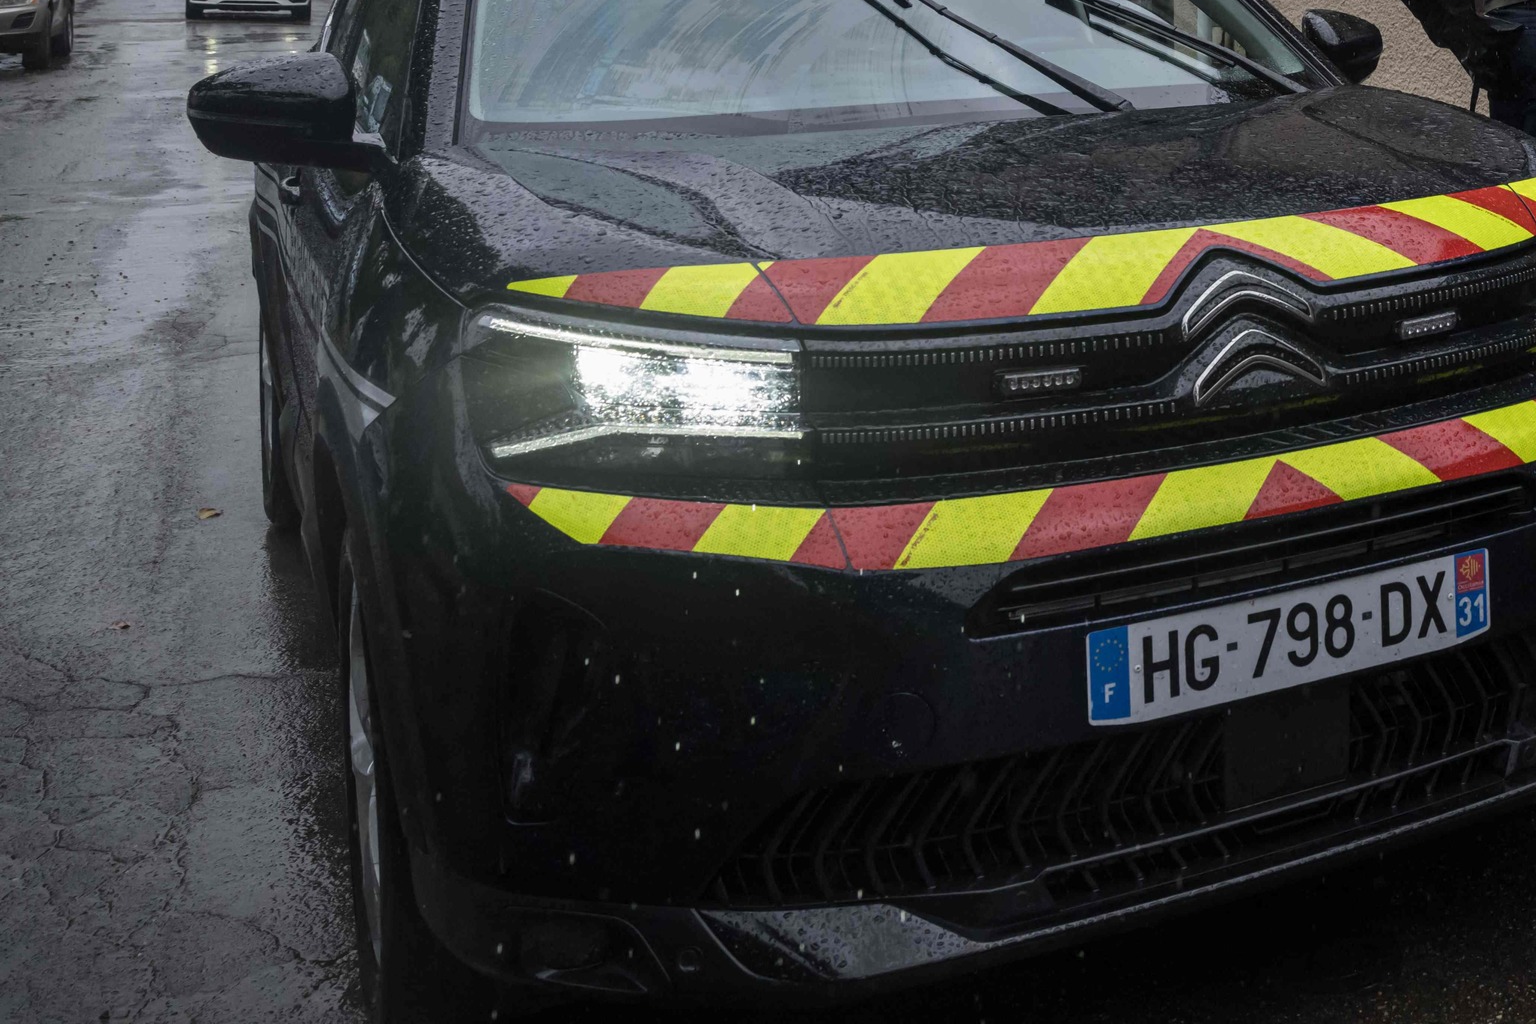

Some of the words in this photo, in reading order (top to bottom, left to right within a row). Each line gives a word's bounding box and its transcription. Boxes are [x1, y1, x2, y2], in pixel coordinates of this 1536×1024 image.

[1458, 593, 1486, 627] 31
[1142, 570, 1448, 704] HG-798-DX
[1104, 682, 1116, 704] F
